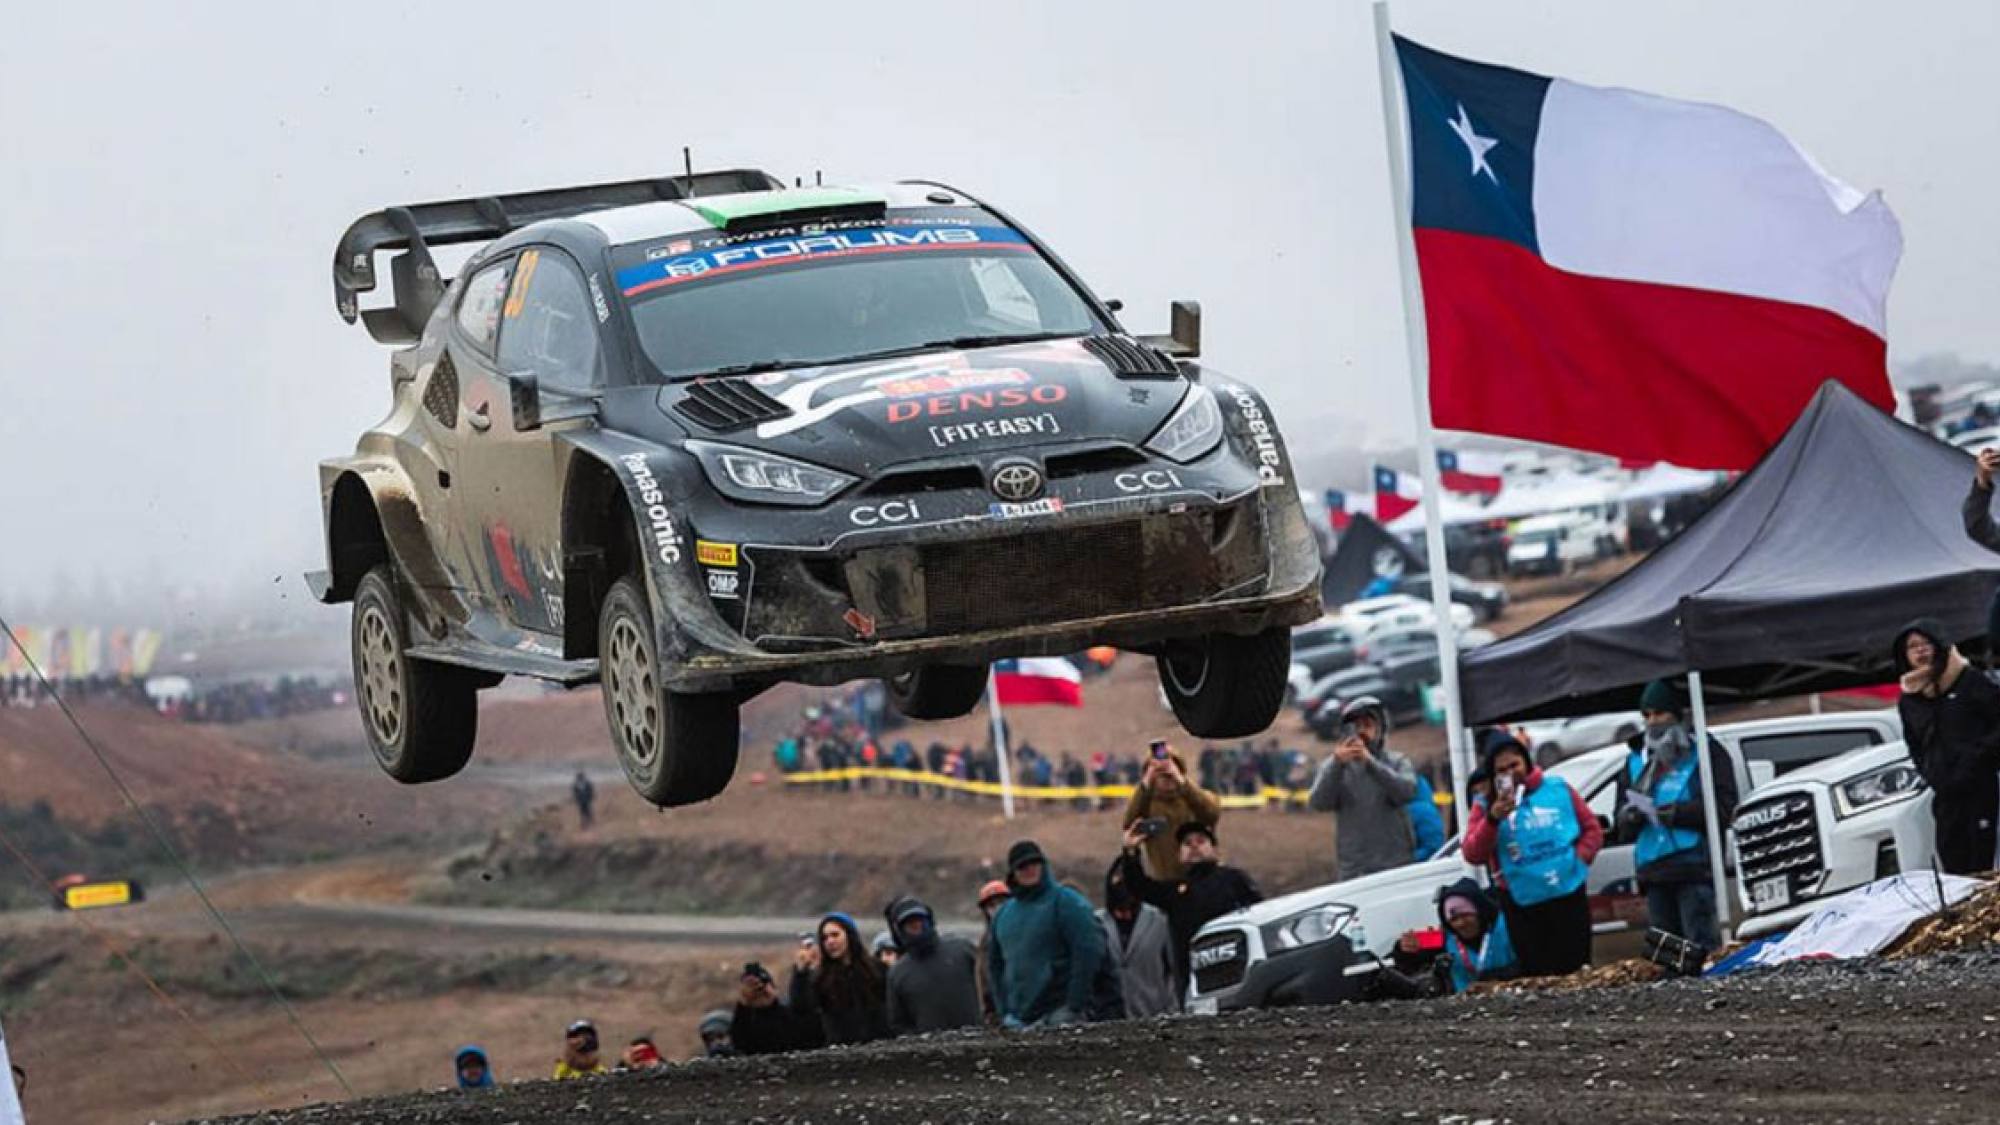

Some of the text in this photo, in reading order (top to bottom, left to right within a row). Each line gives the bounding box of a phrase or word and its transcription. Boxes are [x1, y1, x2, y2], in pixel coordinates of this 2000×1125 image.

[712, 228, 980, 268] FORUM8
[887, 384, 1068, 424] DENSO
[620, 453, 683, 565] Panasonic
[709, 574, 739, 593] OMP
